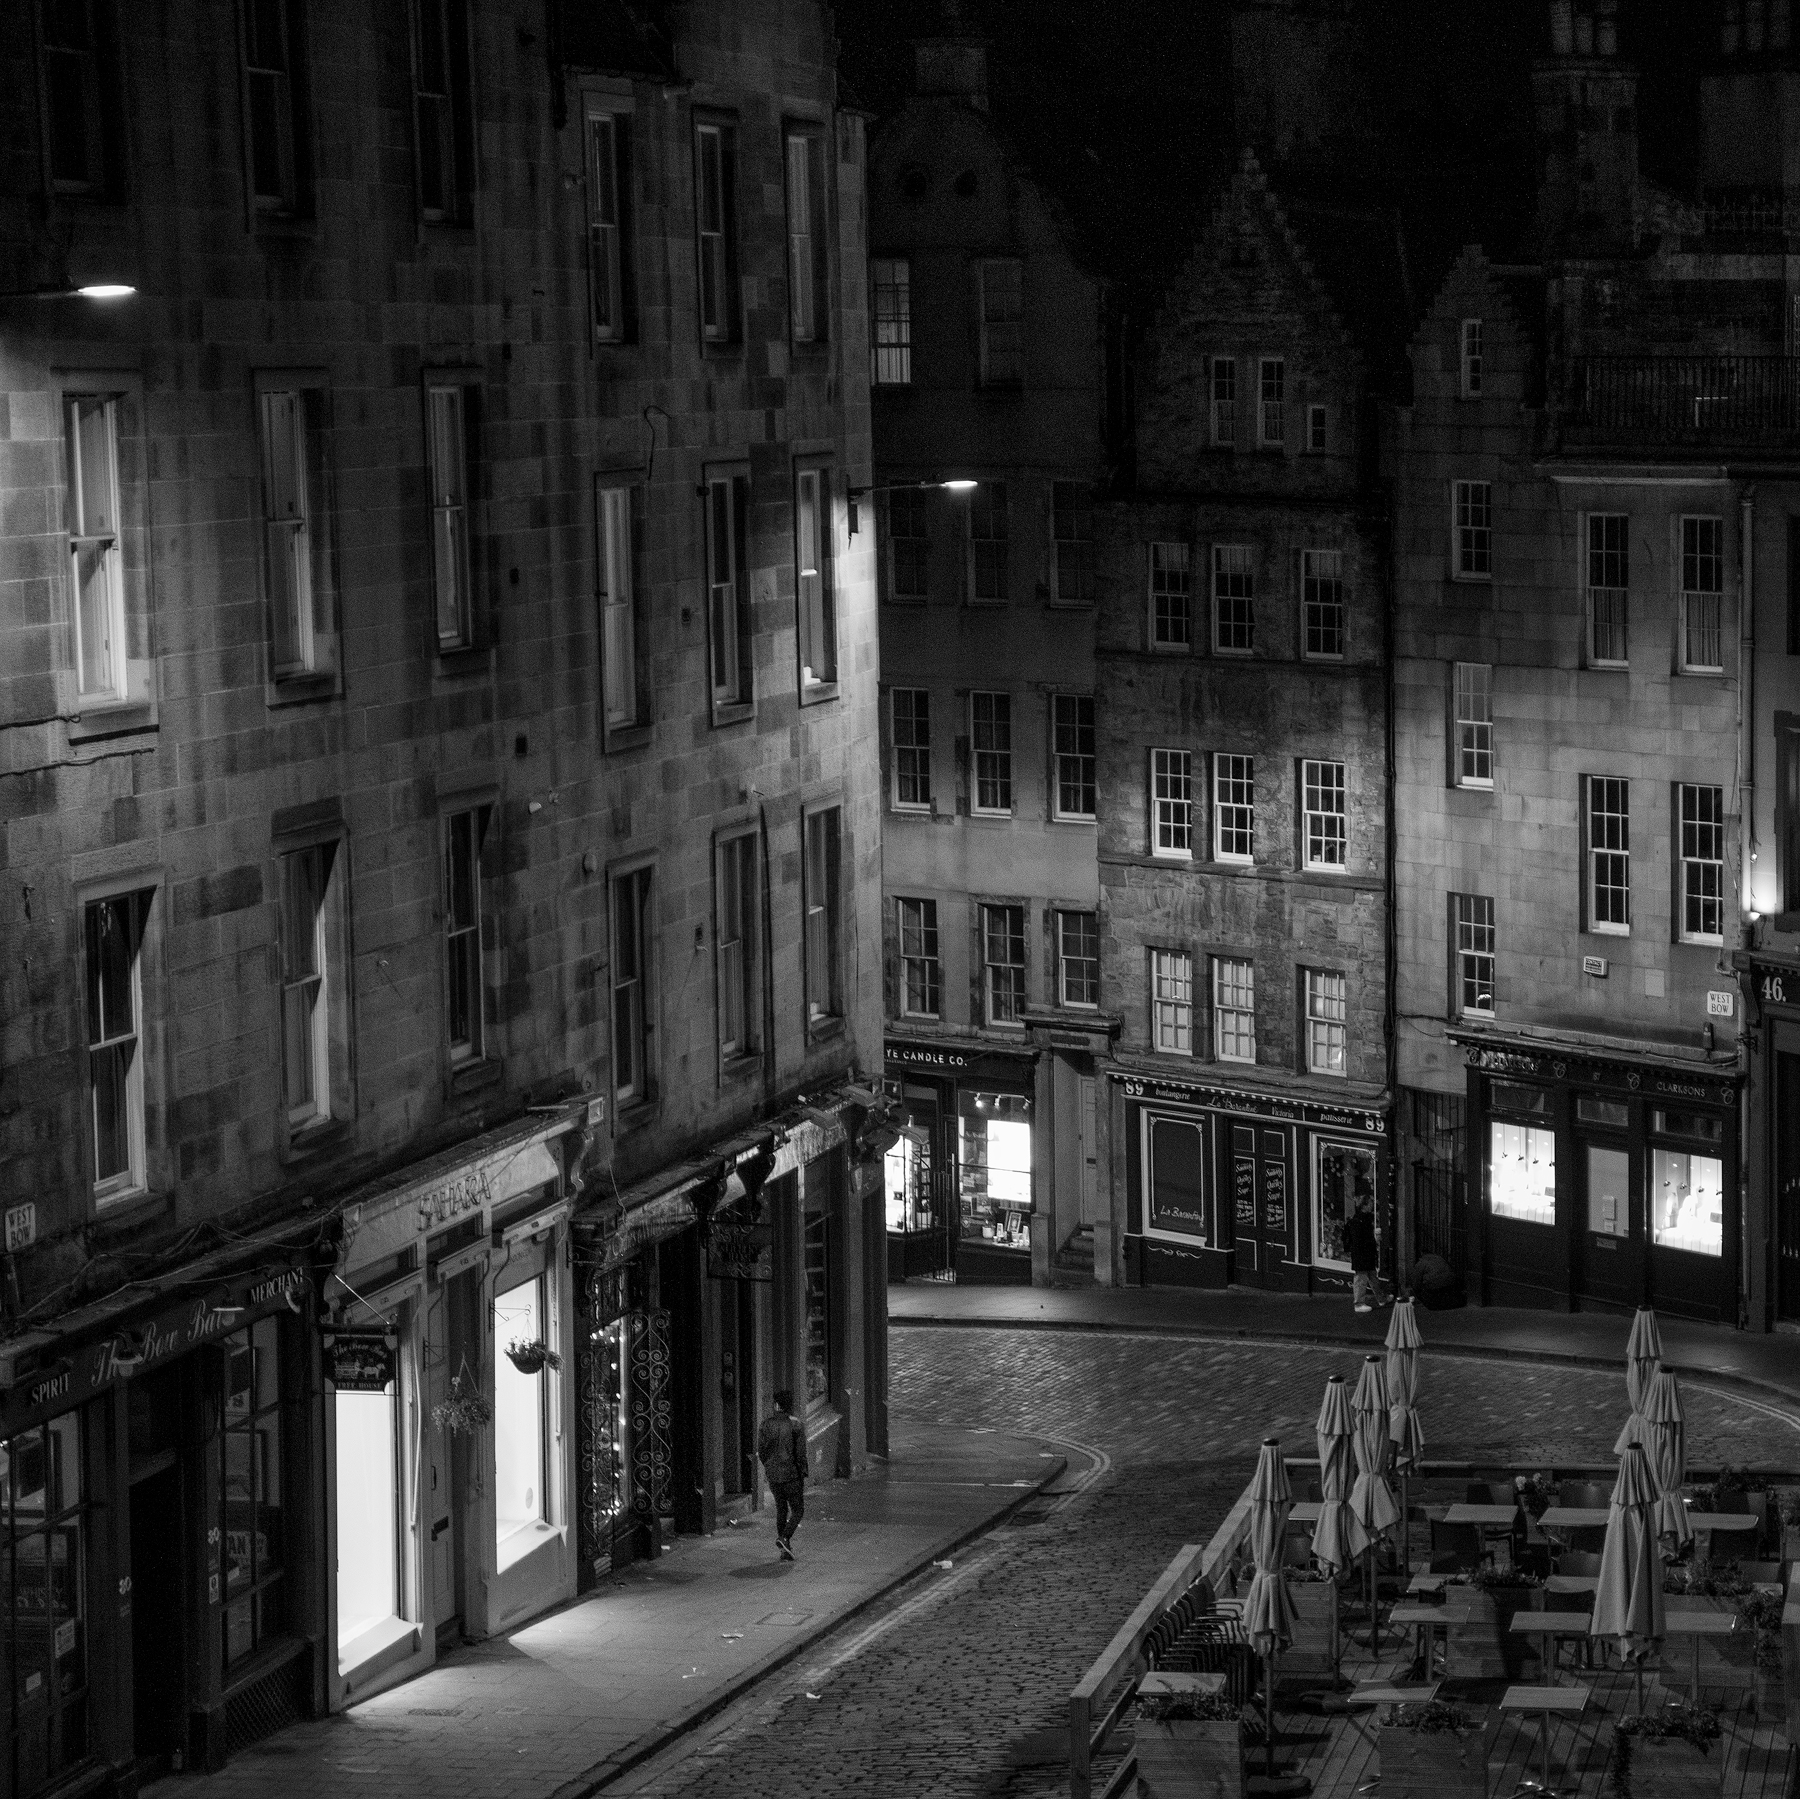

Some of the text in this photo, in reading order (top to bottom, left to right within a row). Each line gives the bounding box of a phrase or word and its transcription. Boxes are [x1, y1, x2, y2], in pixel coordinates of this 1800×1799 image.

[1710, 993, 1731, 1004] WEST
[1761, 976, 1787, 1002] 46.
[1711, 1003, 1729, 1014] BOW
[902, 1050, 945, 1064] CANDLE
[948, 1055, 968, 1067] CO.
[1125, 1081, 1144, 1096] 89
[1656, 1082, 1706, 1098] CLARKSONS
[1365, 1115, 1385, 1132] 89
[418, 1171, 492, 1233] SAHARA
[8, 1204, 32, 1227] WEST
[11, 1225, 31, 1248] BOW
[250, 1266, 303, 1305] MERCHANT
[139, 1321, 178, 1366] Bow
[31, 1371, 71, 1407] SPIRIT
[207, 1526, 220, 1545] 80
[119, 1576, 132, 1595] 80
